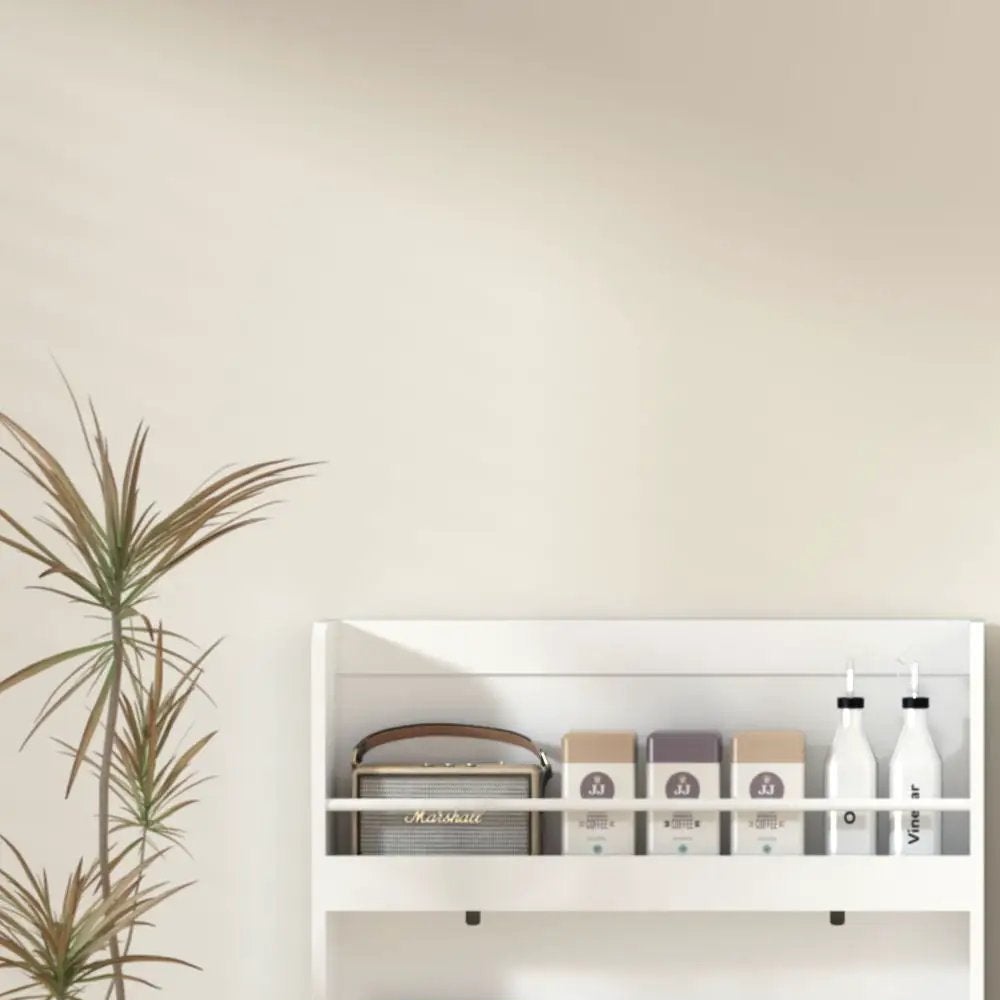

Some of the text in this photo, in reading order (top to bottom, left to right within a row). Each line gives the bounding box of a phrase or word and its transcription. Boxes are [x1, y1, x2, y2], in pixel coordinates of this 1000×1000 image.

[588, 784, 605, 795] JJ
[673, 784, 691, 795] JJ
[758, 784, 775, 795] JJ
[404, 810, 485, 824] Marshall
[907, 783, 920, 845] Vinear
